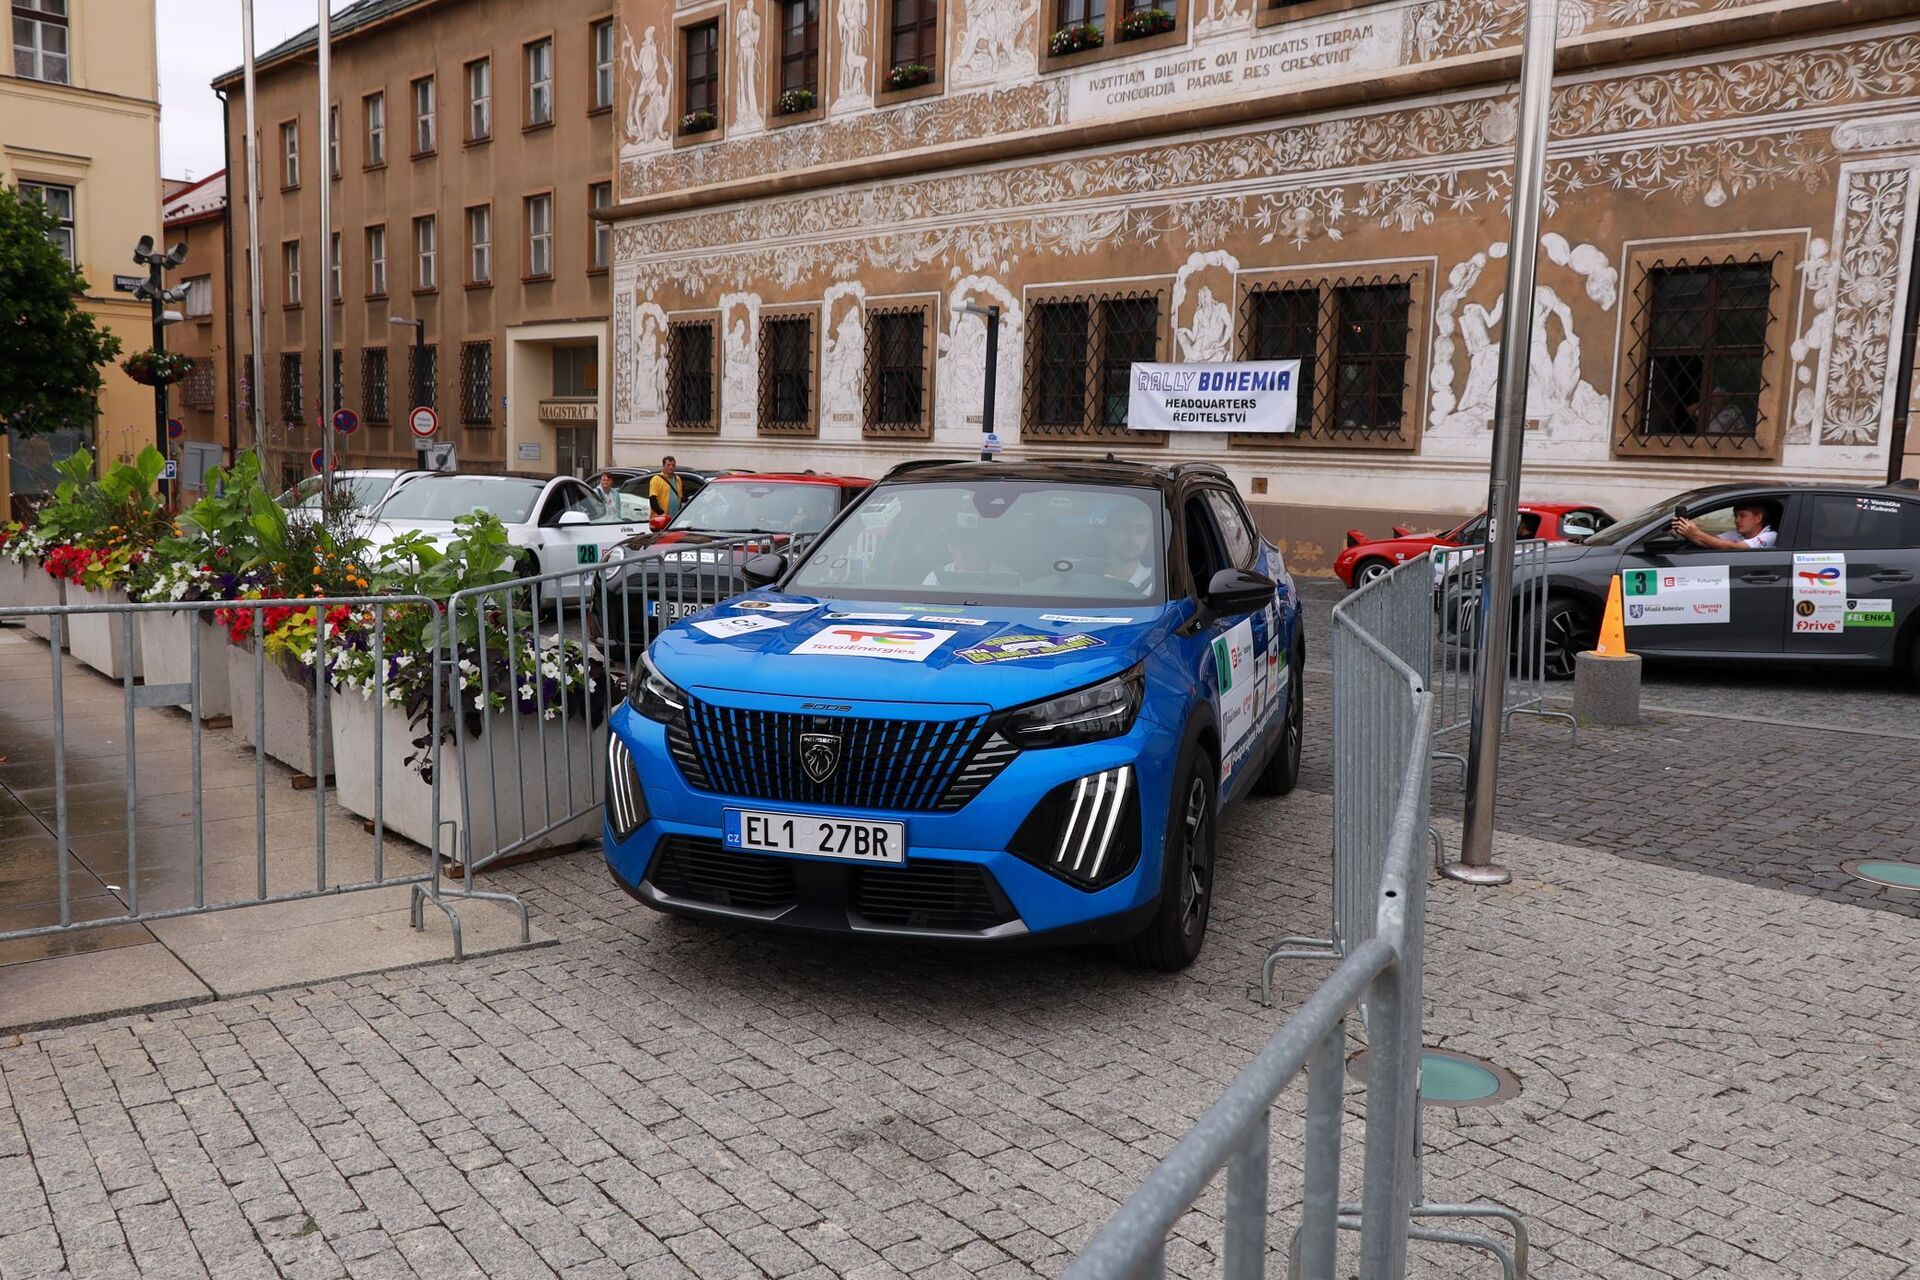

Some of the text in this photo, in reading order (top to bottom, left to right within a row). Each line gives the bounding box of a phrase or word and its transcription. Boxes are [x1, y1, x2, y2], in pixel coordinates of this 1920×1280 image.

[1089, 24, 1374, 92] IVSTITIAM DILIGITE QVI IVDICATIS TERRAM
[1106, 48, 1352, 105] CONCORDIA PARVAE RES CRESCVNT
[1138, 371, 1291, 391] RALLY BOHEMIA
[541, 403, 588, 418] MAGISTRÁT
[1165, 398, 1257, 409] HEADQUARTERS
[1173, 410, 1247, 423] ŘEDITELSTVÍ
[580, 545, 595, 564] 28
[1635, 572, 1647, 595] 3
[812, 643, 917, 655] TotalEnergies
[800, 702, 853, 712] 2008
[727, 816, 888, 857] CZ EL1 27BR
